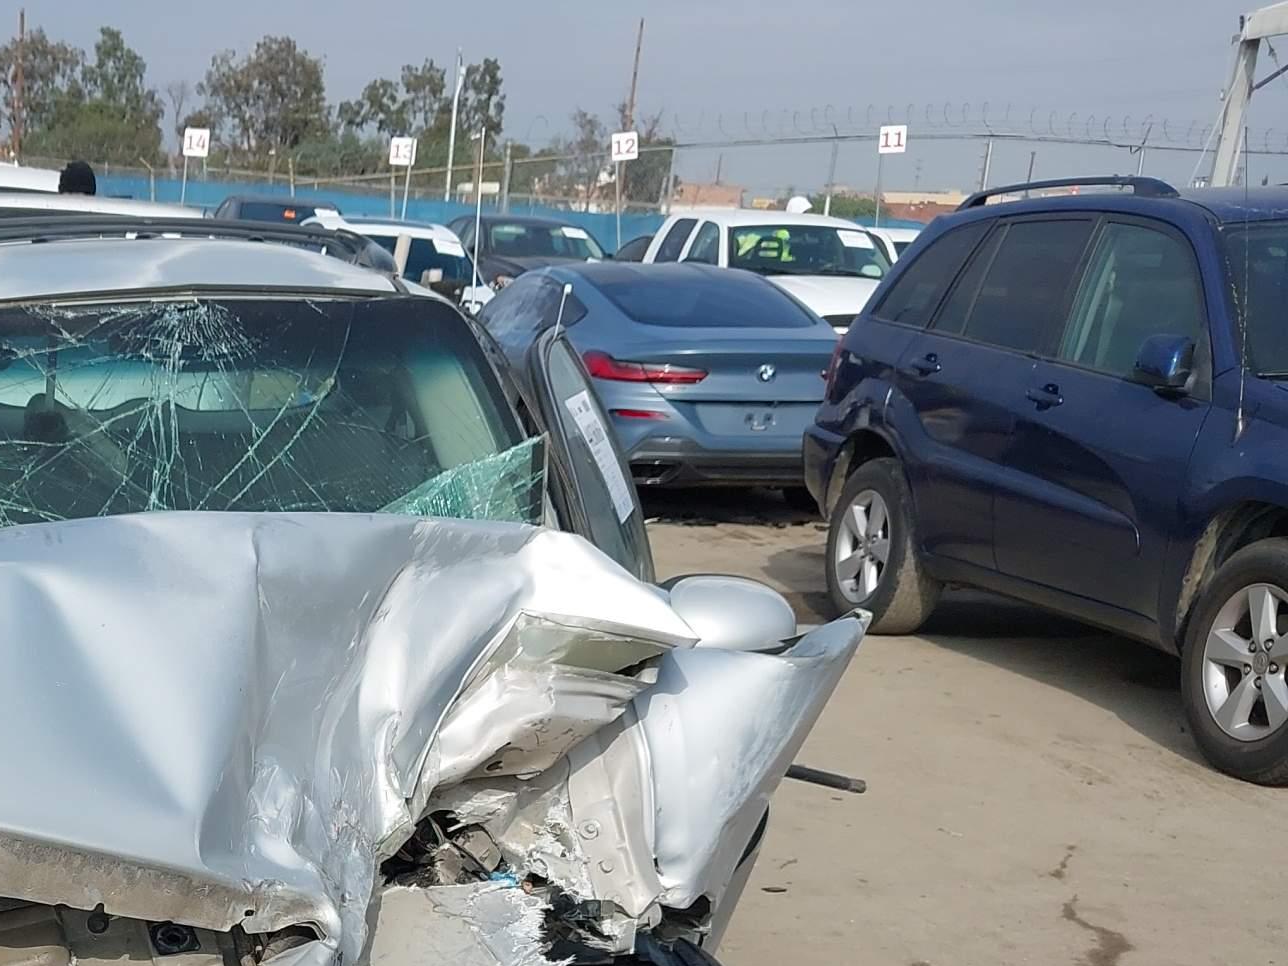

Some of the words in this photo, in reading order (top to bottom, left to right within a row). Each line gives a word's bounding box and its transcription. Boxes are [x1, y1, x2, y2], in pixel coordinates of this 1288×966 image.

[186, 133, 206, 150] 14
[615, 137, 636, 154] 12
[882, 132, 902, 148] 11
[393, 143, 412, 159] 13
